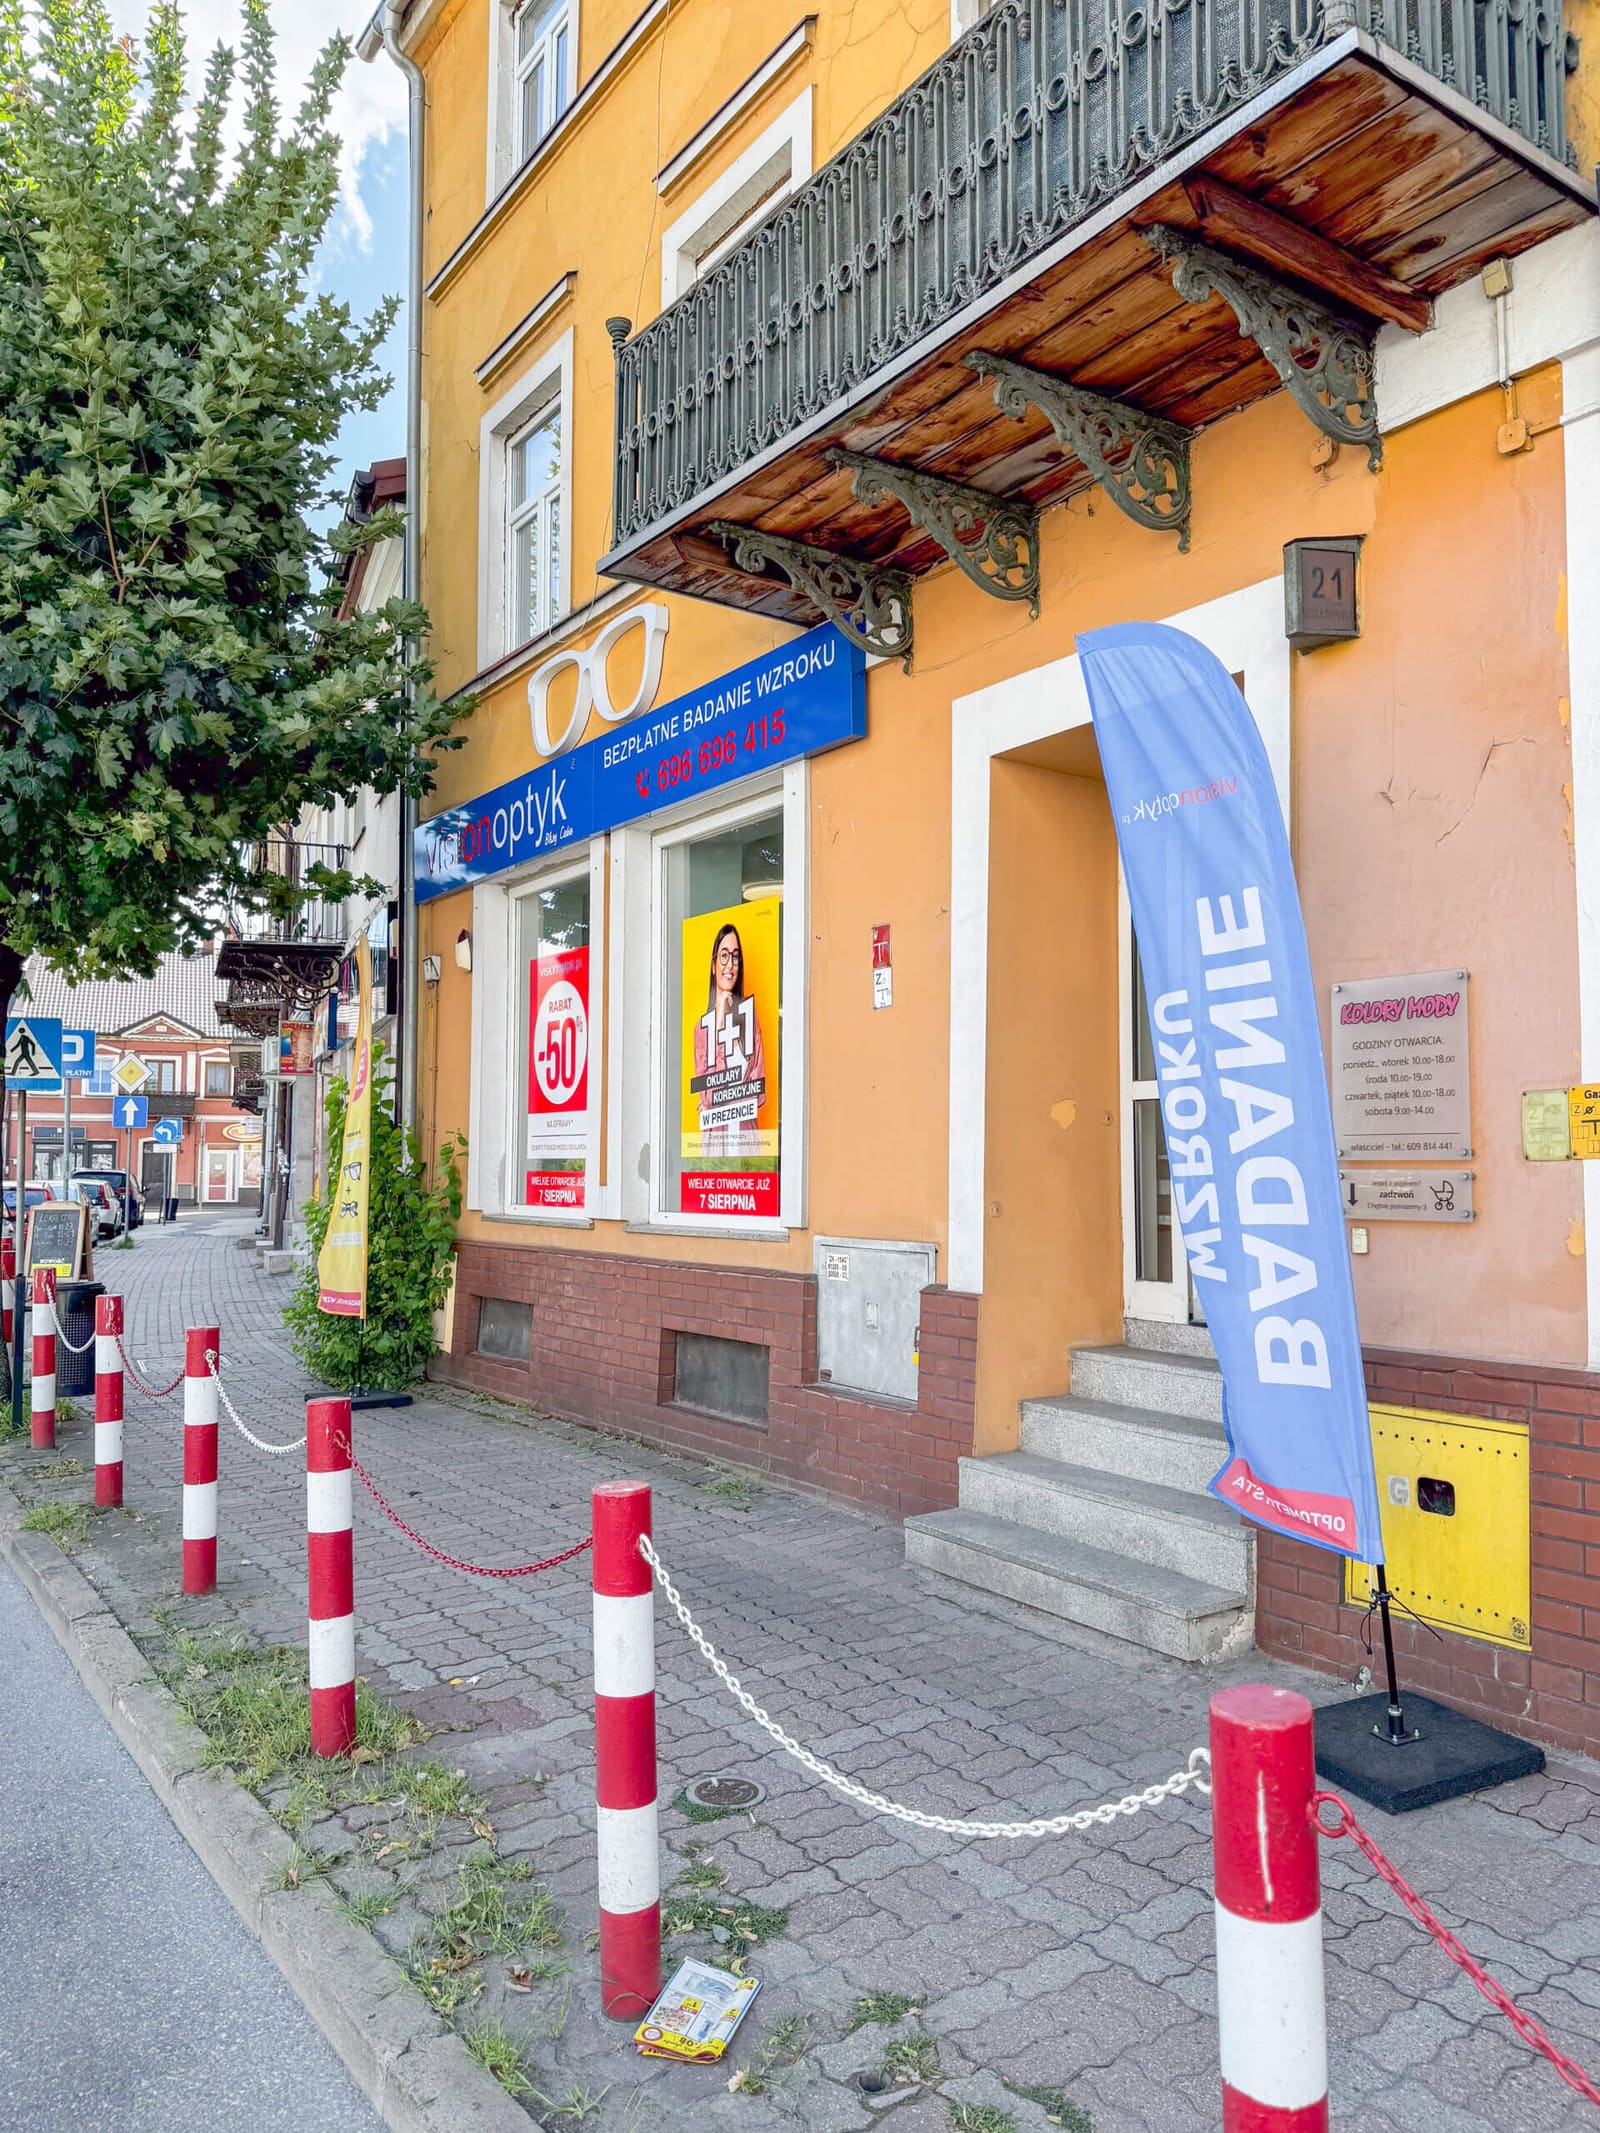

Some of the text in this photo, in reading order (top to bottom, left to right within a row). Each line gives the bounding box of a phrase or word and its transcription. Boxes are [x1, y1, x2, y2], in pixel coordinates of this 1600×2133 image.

[1312, 566, 1342, 601] 21
[603, 639, 836, 769] BEZPŁATNE BADANIE WZROKU
[657, 708, 786, 791] 696 696 415
[548, 997, 573, 1013] RABAT
[1340, 991, 1460, 1025] KOLORY MODY
[700, 993, 755, 1069] 1+1
[1352, 1036, 1445, 1051] GODZINY OTWARCIA:
[1381, 1056, 1409, 1067] wtorek
[1412, 1055, 1456, 1065] 10.00-18.00
[706, 1067, 741, 1088] OKULARY
[1365, 1072, 1432, 1084] środa 10.00-19.00
[712, 1080, 762, 1105] KOREKCYJNE
[1384, 1090, 1409, 1101] piątek
[1412, 1088, 1456, 1098] 10.00-18.00
[702, 1103, 754, 1126] W PREZENCIE
[1365, 1106, 1434, 1116] sobota 9.00-14.00
[1350, 1142, 1384, 1152] właściciel
[1406, 1142, 1421, 1151] 609
[1423, 1142, 1437, 1150] 814
[688, 1176, 771, 1190] WIELKIE OTWARCIE JUŻ
[544, 1190, 577, 1204] SIERPNIA
[700, 1194, 756, 1211] 7 SIERPNIA
[1379, 1190, 1414, 1199] zadzwoń
[1390, 1477, 1409, 1504] G
